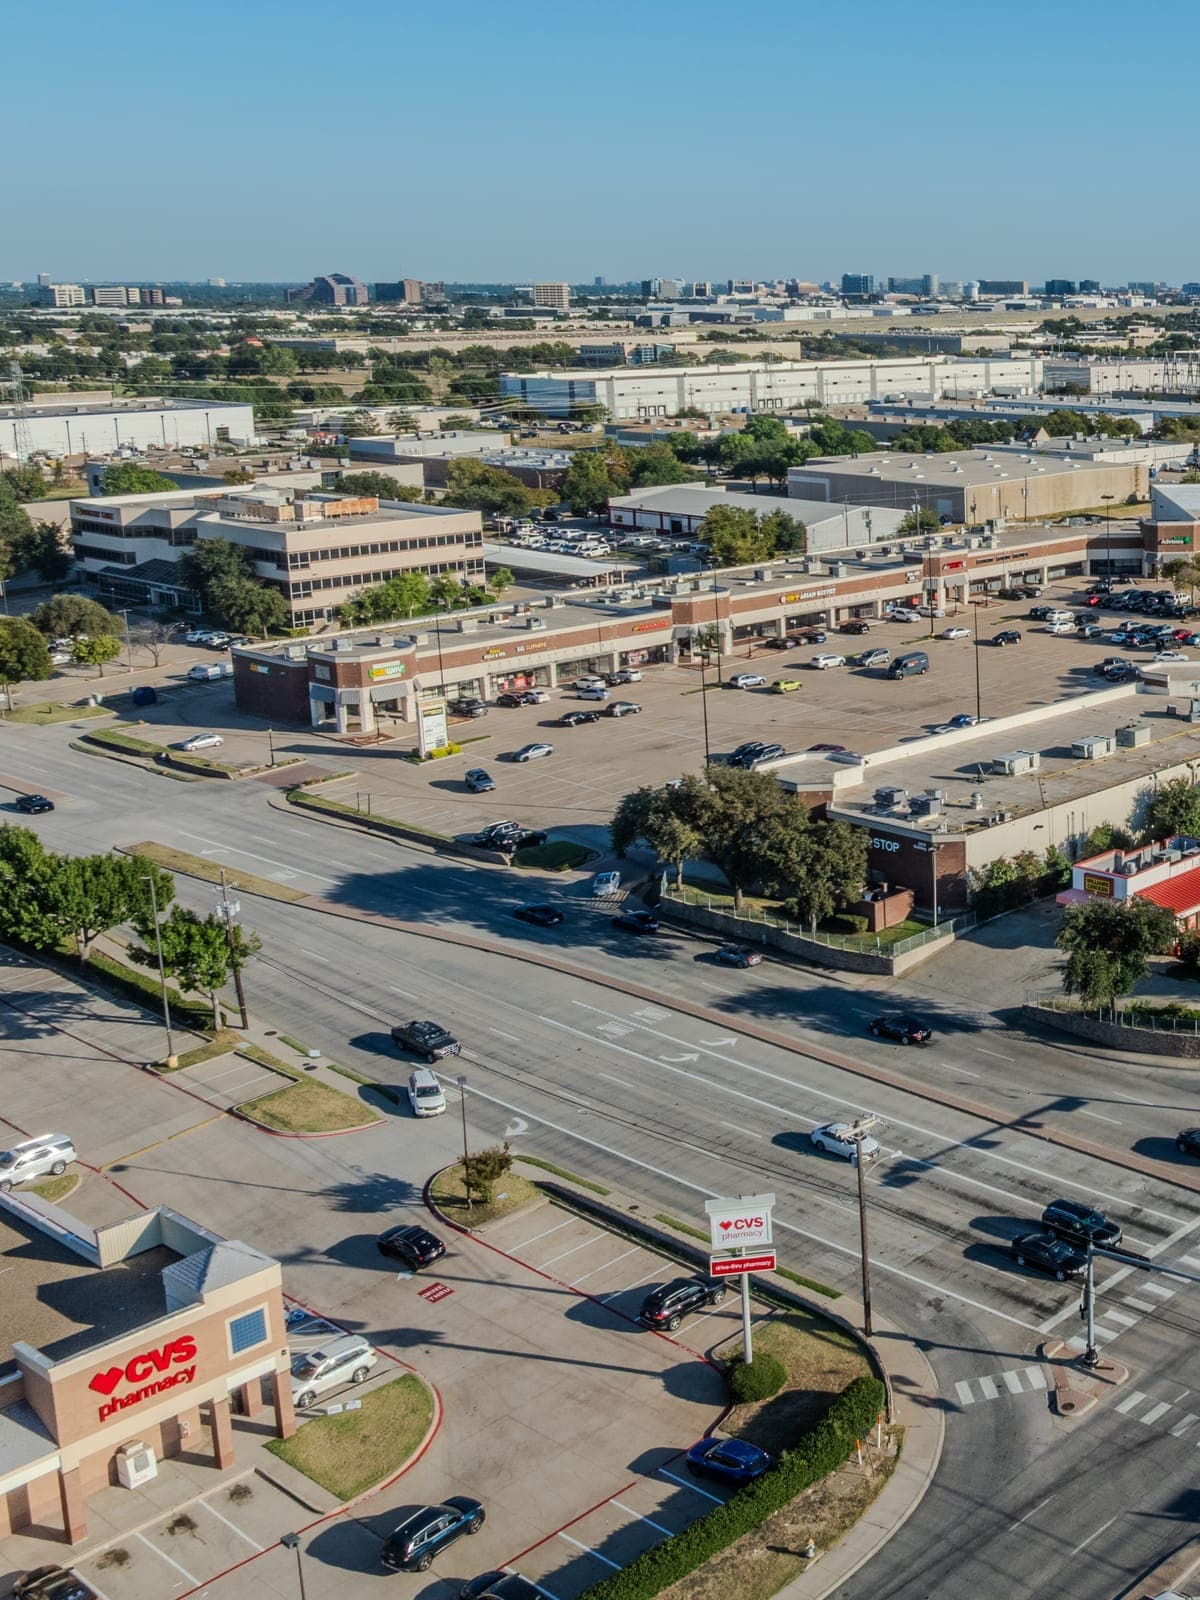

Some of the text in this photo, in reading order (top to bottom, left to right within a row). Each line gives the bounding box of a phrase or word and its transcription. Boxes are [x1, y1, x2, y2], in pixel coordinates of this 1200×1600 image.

[873, 838, 900, 852] STOP
[734, 1216, 764, 1230] CVS
[721, 1230, 764, 1241] pharmacy
[743, 1260, 771, 1268] pharmacy
[125, 1335, 197, 1383] CVS
[98, 1365, 197, 1422] pharmacy
